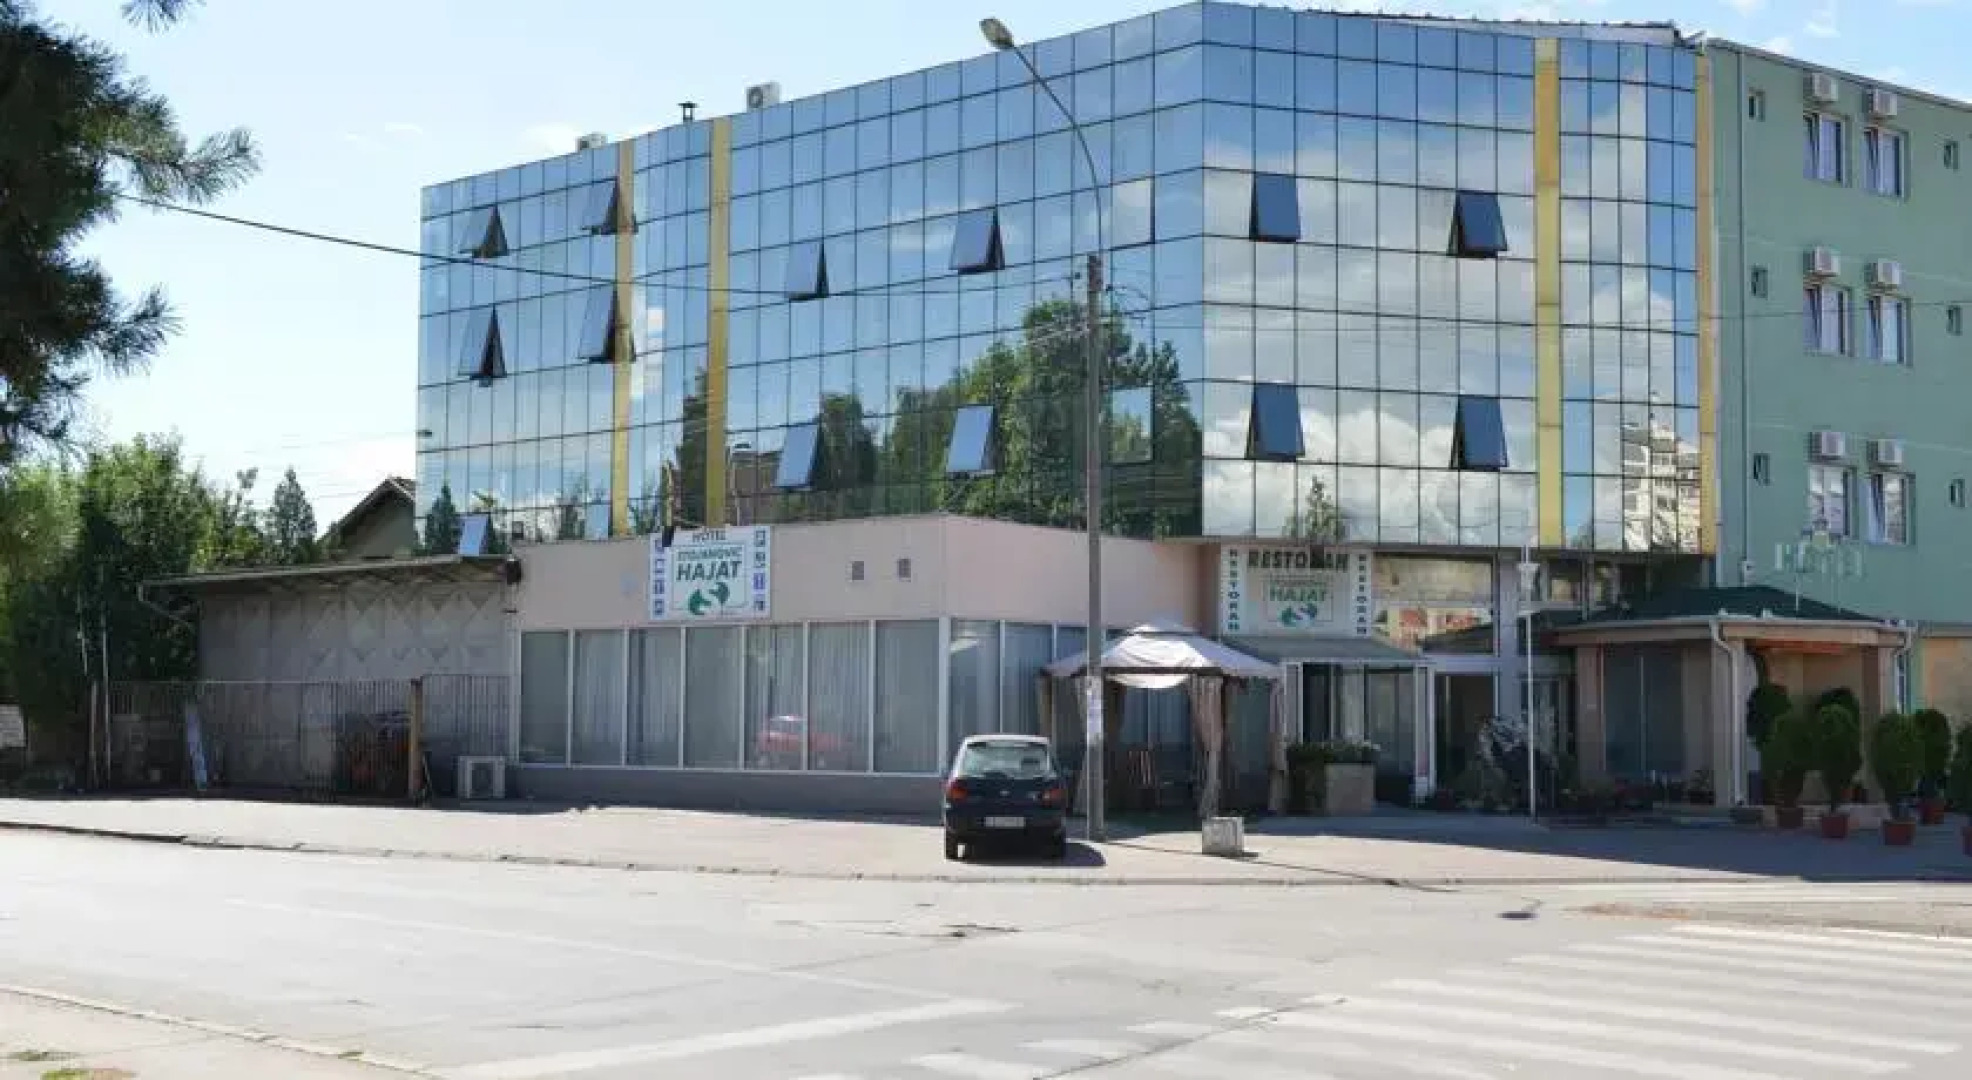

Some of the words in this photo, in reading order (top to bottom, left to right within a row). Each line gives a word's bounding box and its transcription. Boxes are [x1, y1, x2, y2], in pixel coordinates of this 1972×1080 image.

[692, 530, 726, 543] HOTEL
[1249, 550, 1348, 571] RESTOAN
[676, 560, 742, 581] HAJAT
[1269, 585, 1326, 601] HAJAT
